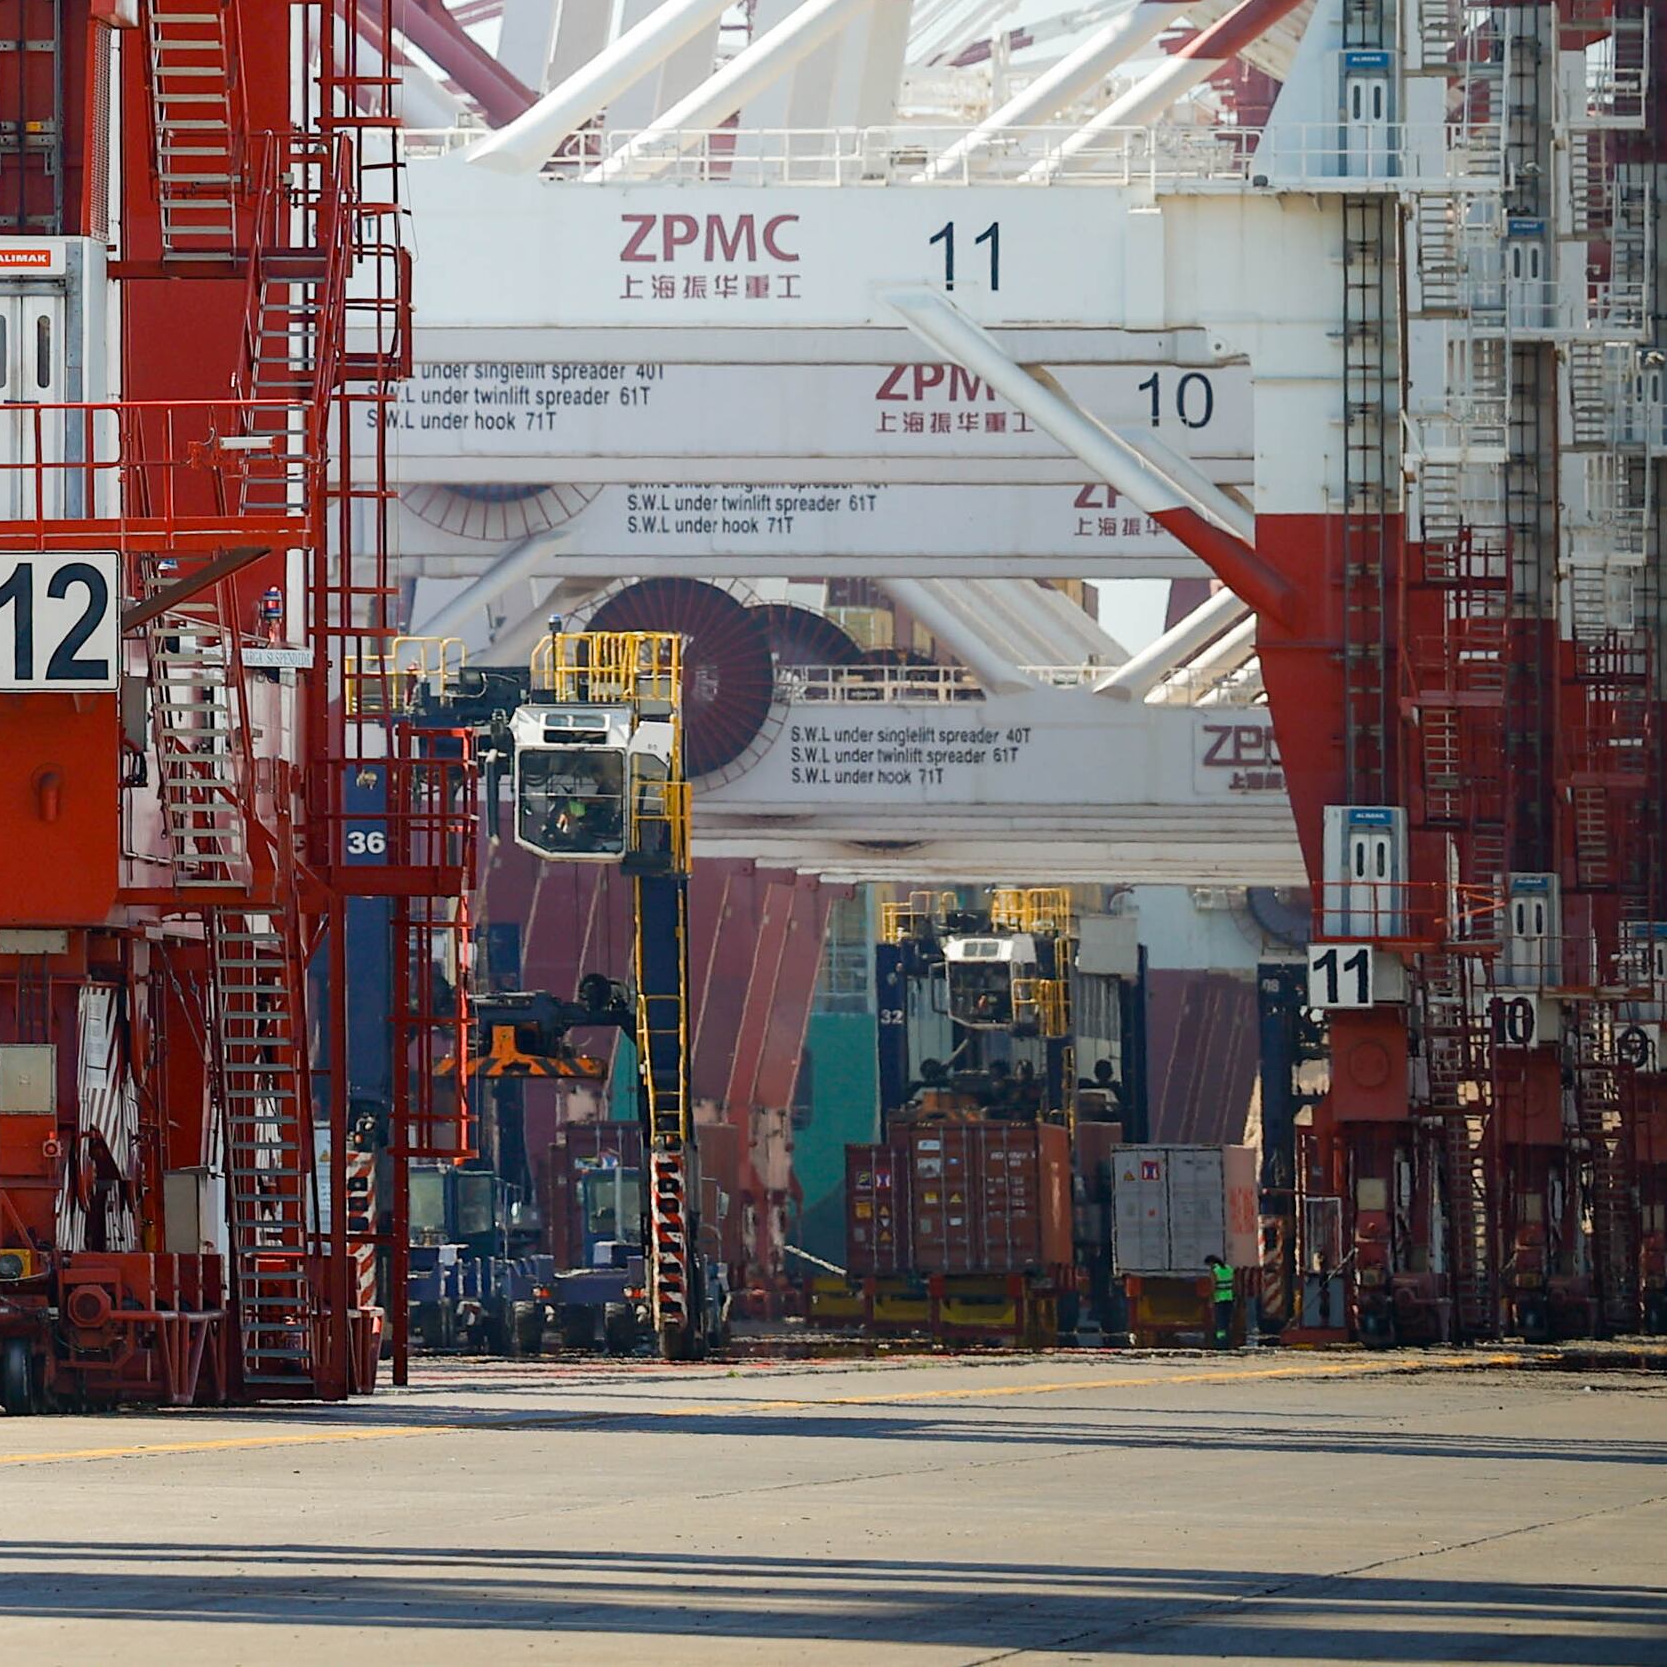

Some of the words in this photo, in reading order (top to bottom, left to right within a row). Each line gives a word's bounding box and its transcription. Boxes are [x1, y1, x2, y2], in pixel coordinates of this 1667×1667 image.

[619, 214, 801, 263] ZPMC
[929, 221, 1000, 291] 11
[619, 274, 802, 300] 上海振华重工
[875, 364, 995, 402] ZPM
[421, 385, 469, 405] under
[474, 385, 530, 405] twinlift
[535, 385, 610, 409] spreader
[619, 386, 652, 406] 61T
[1138, 371, 1214, 429] 10
[421, 409, 469, 430] under
[474, 409, 516, 430] hook
[525, 411, 557, 430] 71T
[627, 494, 670, 512] S.W.L
[675, 494, 718, 512] under
[722, 494, 772, 512] twinlift
[775, 494, 841, 516] spreader
[849, 494, 878, 512] 61T
[627, 515, 670, 533] S.W.L
[675, 515, 718, 533] under
[722, 515, 759, 533] hook
[768, 515, 795, 533] 71T
[791, 726, 831, 743] S.W.L
[834, 726, 874, 743] under
[878, 726, 936, 746] singlelift
[938, 727, 999, 746] spreader
[1006, 727, 1032, 743] 40T
[791, 747, 831, 763] S.W.L
[834, 747, 874, 763] under
[877, 747, 923, 763] twinlift
[926, 747, 986, 766] spreader
[993, 747, 1019, 763] 61T
[791, 767, 831, 784] S.W.L
[834, 767, 874, 784] under
[877, 767, 912, 784] hook
[918, 767, 944, 784] 71T
[347, 831, 386, 855] 36
[1313, 948, 1369, 1004] 11
[880, 1008, 904, 1025] 32
